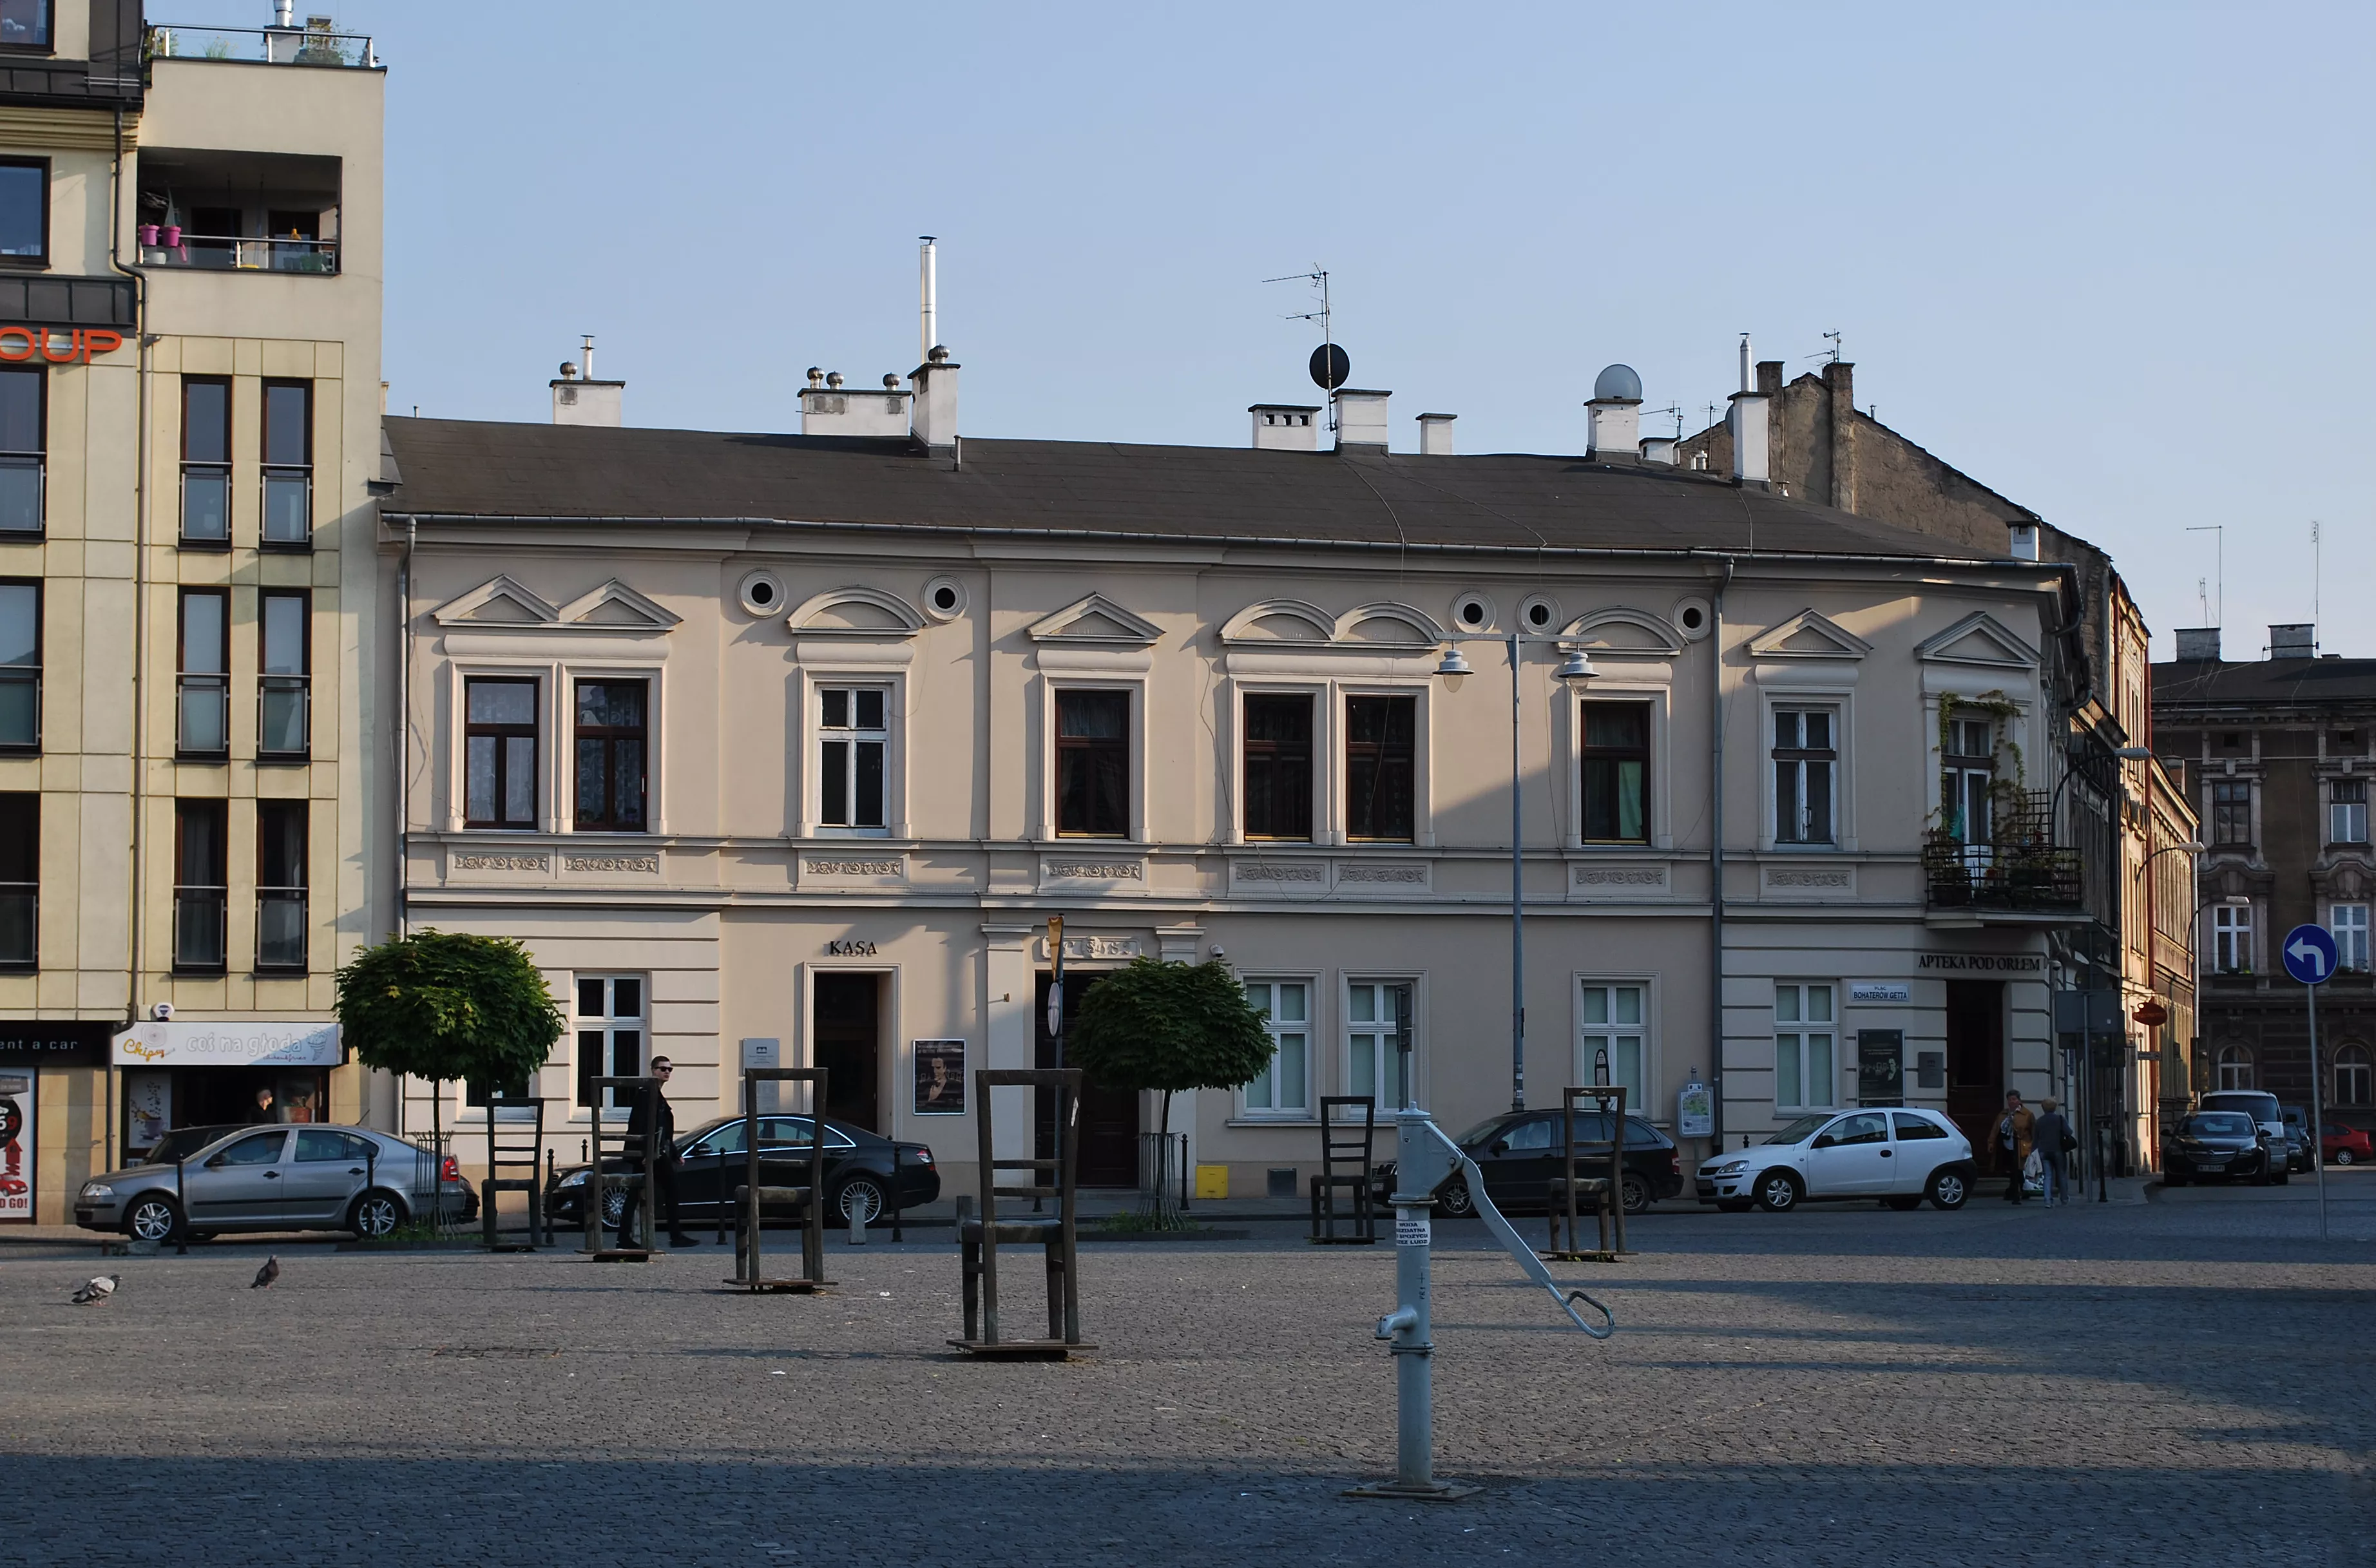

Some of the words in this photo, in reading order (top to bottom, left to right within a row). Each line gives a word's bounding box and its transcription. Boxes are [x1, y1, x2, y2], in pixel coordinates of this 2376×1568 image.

[0, 326, 122, 364] OUP
[830, 941, 878, 955] KASA
[1919, 954, 1966, 969] APTEKA
[1969, 955, 1995, 970] POD
[1997, 957, 2041, 971] ORŁEM
[1854, 991, 1888, 999] BOHATERÓW
[0, 1039, 23, 1050] ent
[32, 1041, 41, 1049] a
[50, 1041, 78, 1049] car
[186, 1032, 215, 1053] coś
[220, 1037, 243, 1053] na
[247, 1033, 302, 1057] głoda
[9, 1198, 28, 1209] GO!
